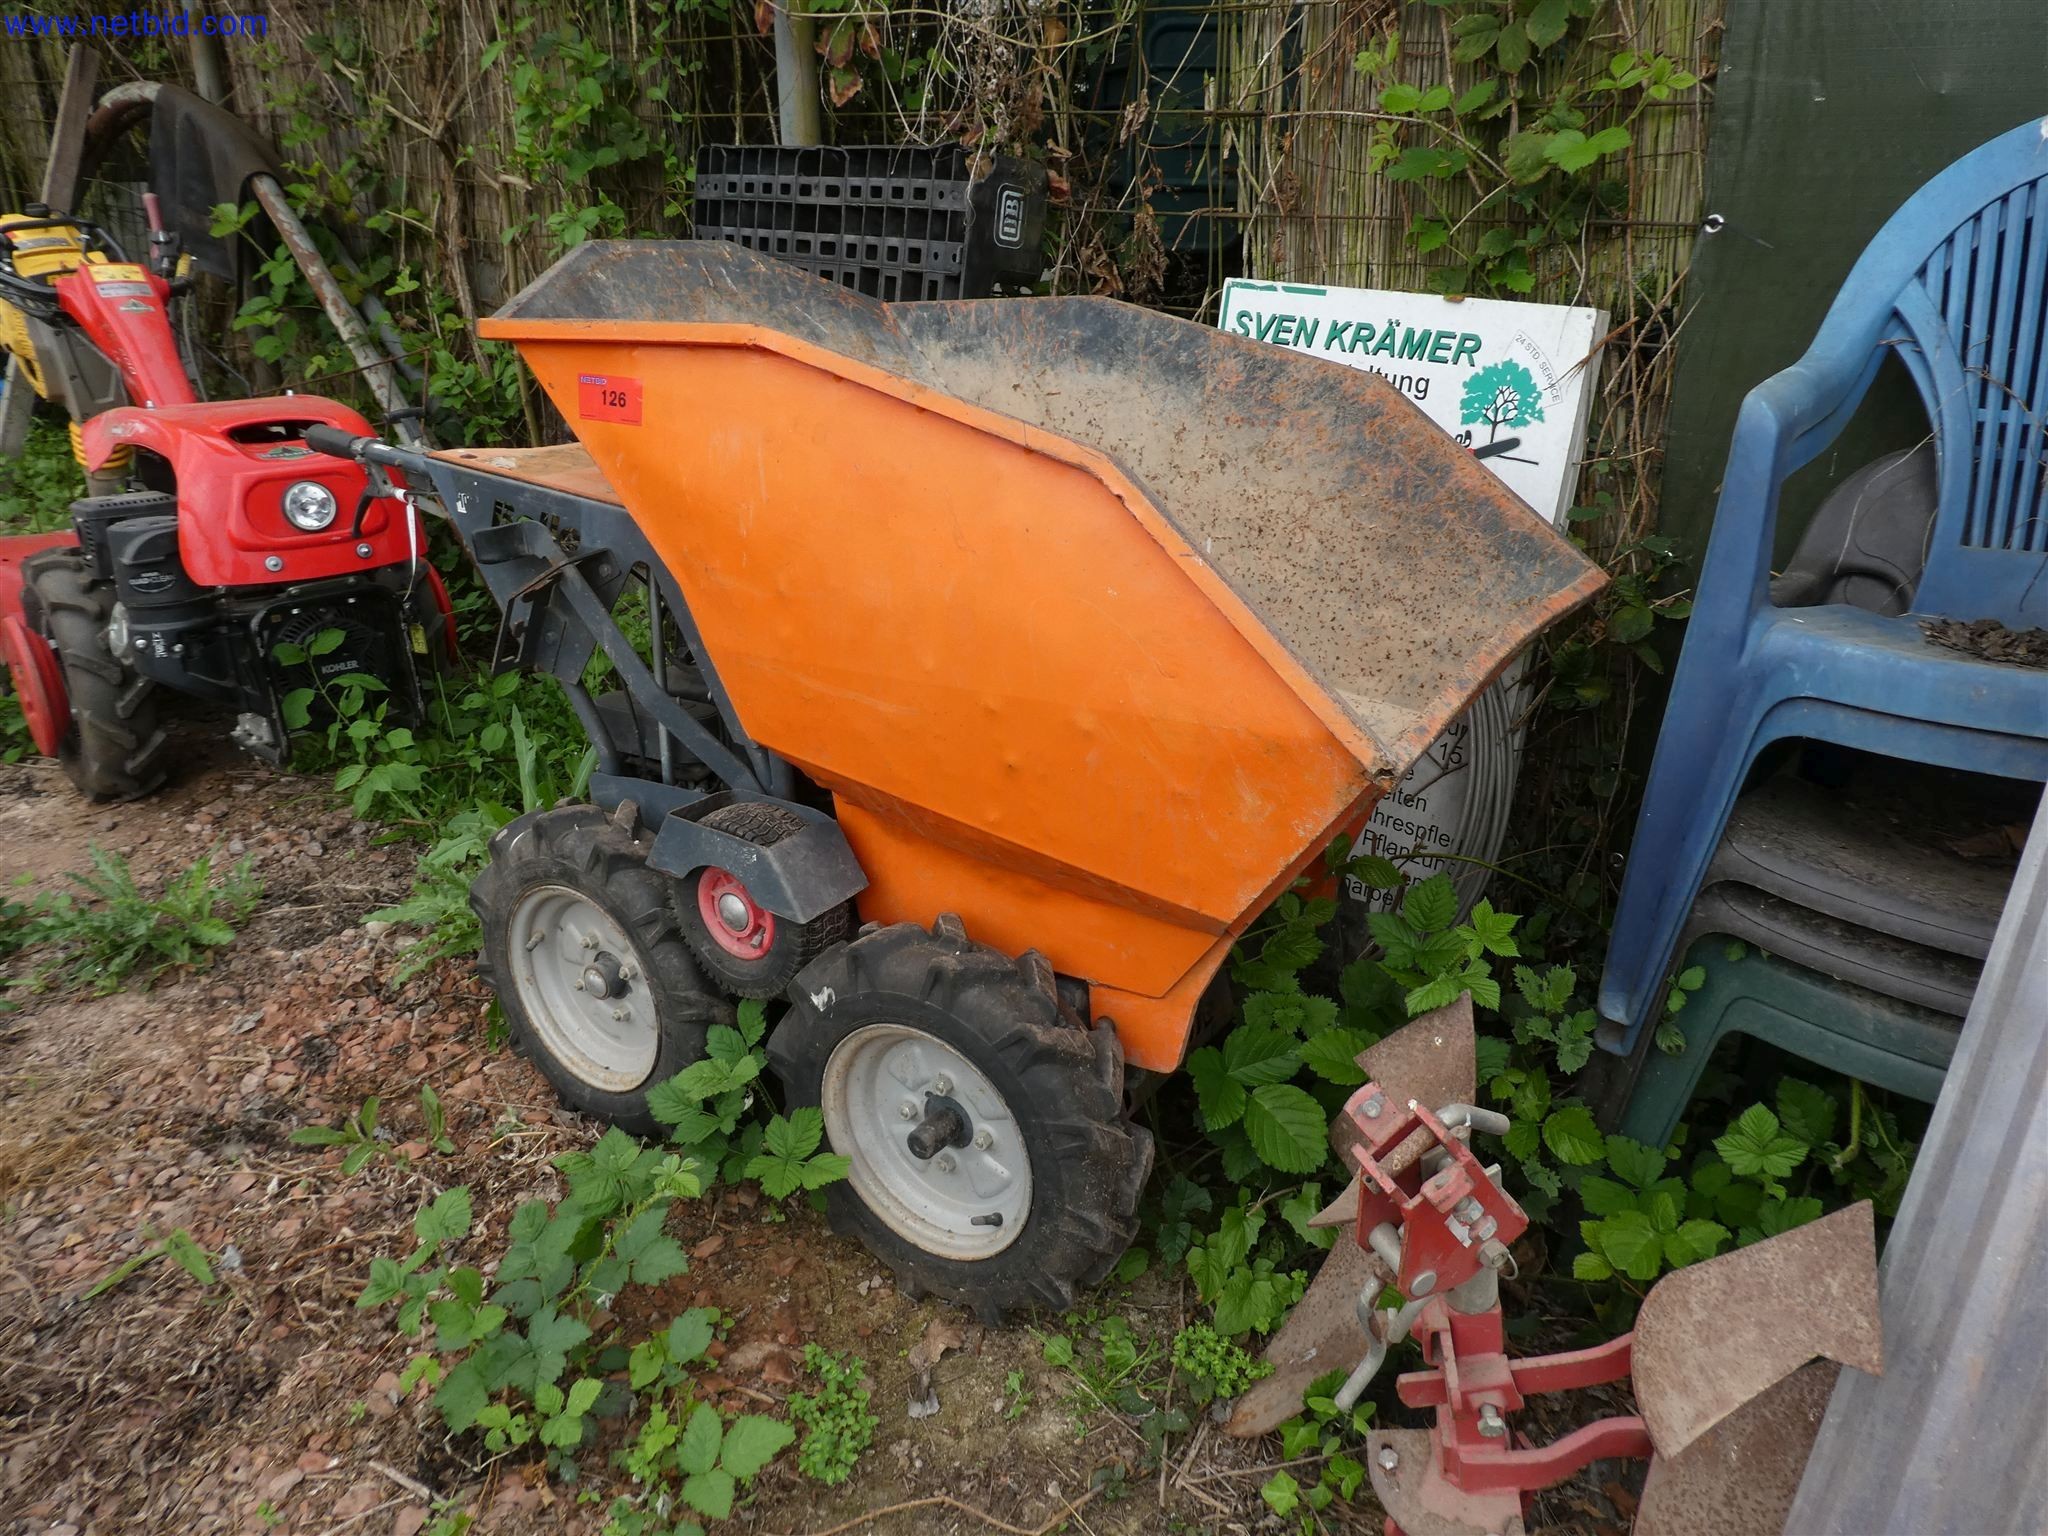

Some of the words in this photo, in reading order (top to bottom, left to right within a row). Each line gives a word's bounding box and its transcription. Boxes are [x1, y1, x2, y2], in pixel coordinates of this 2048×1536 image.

[1232, 309, 1320, 349] SVEN
[1324, 318, 1482, 367] KRÄMER
[1515, 334, 1526, 345] 24
[602, 389, 626, 408] 126
[321, 660, 360, 674] KOHLER
[1440, 742, 1463, 764] 15
